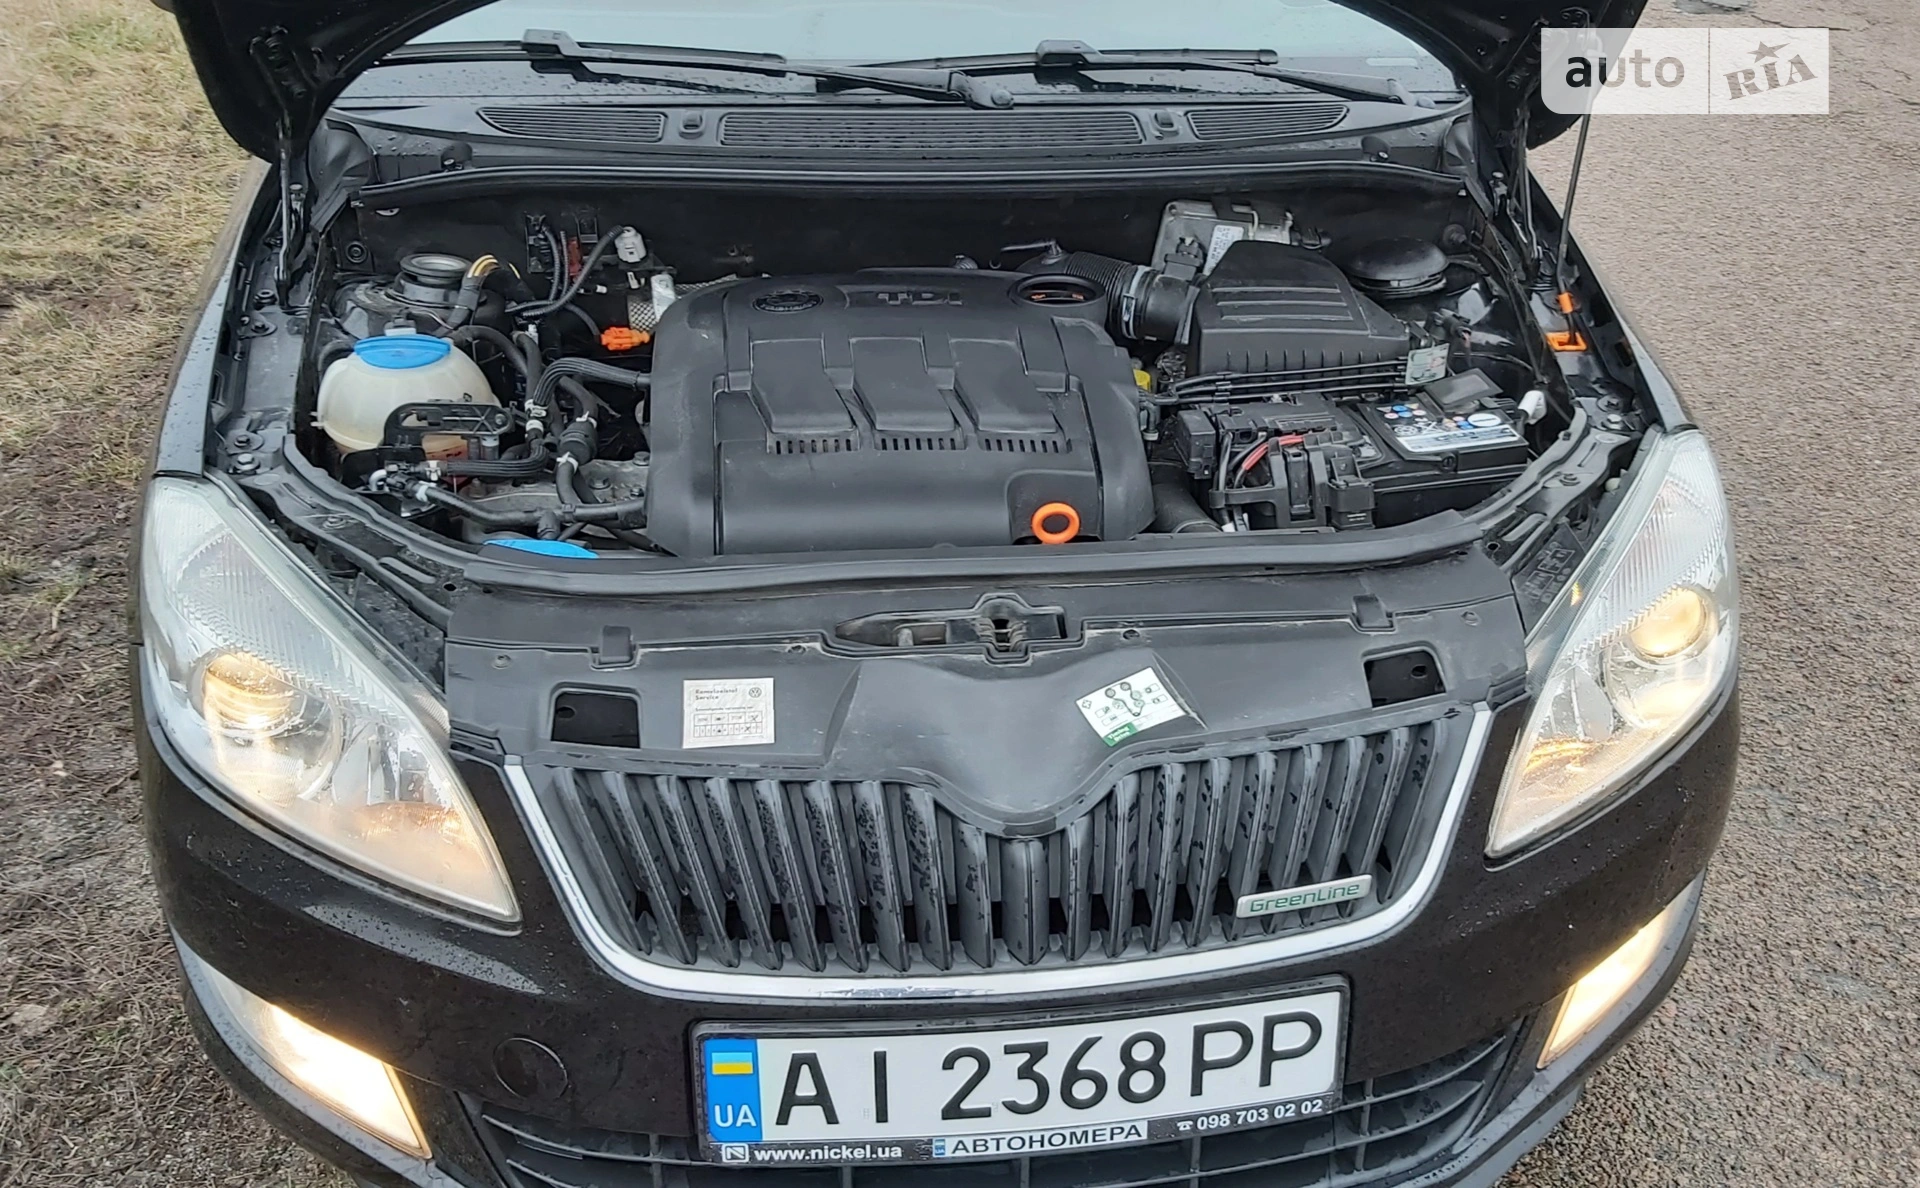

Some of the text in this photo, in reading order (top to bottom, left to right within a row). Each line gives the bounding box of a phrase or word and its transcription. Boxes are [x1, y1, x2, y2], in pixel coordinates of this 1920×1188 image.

[876, 291, 963, 306] TDI
[1250, 884, 1360, 913] GreenLine
[775, 1011, 1322, 1126] AI 2368 PP
[714, 1104, 757, 1128] UA
[1197, 1099, 1323, 1130] 098 703 02 02
[754, 1144, 902, 1162] www.nickel.ua
[951, 1124, 1143, 1154] АВТОНОМЕРА
